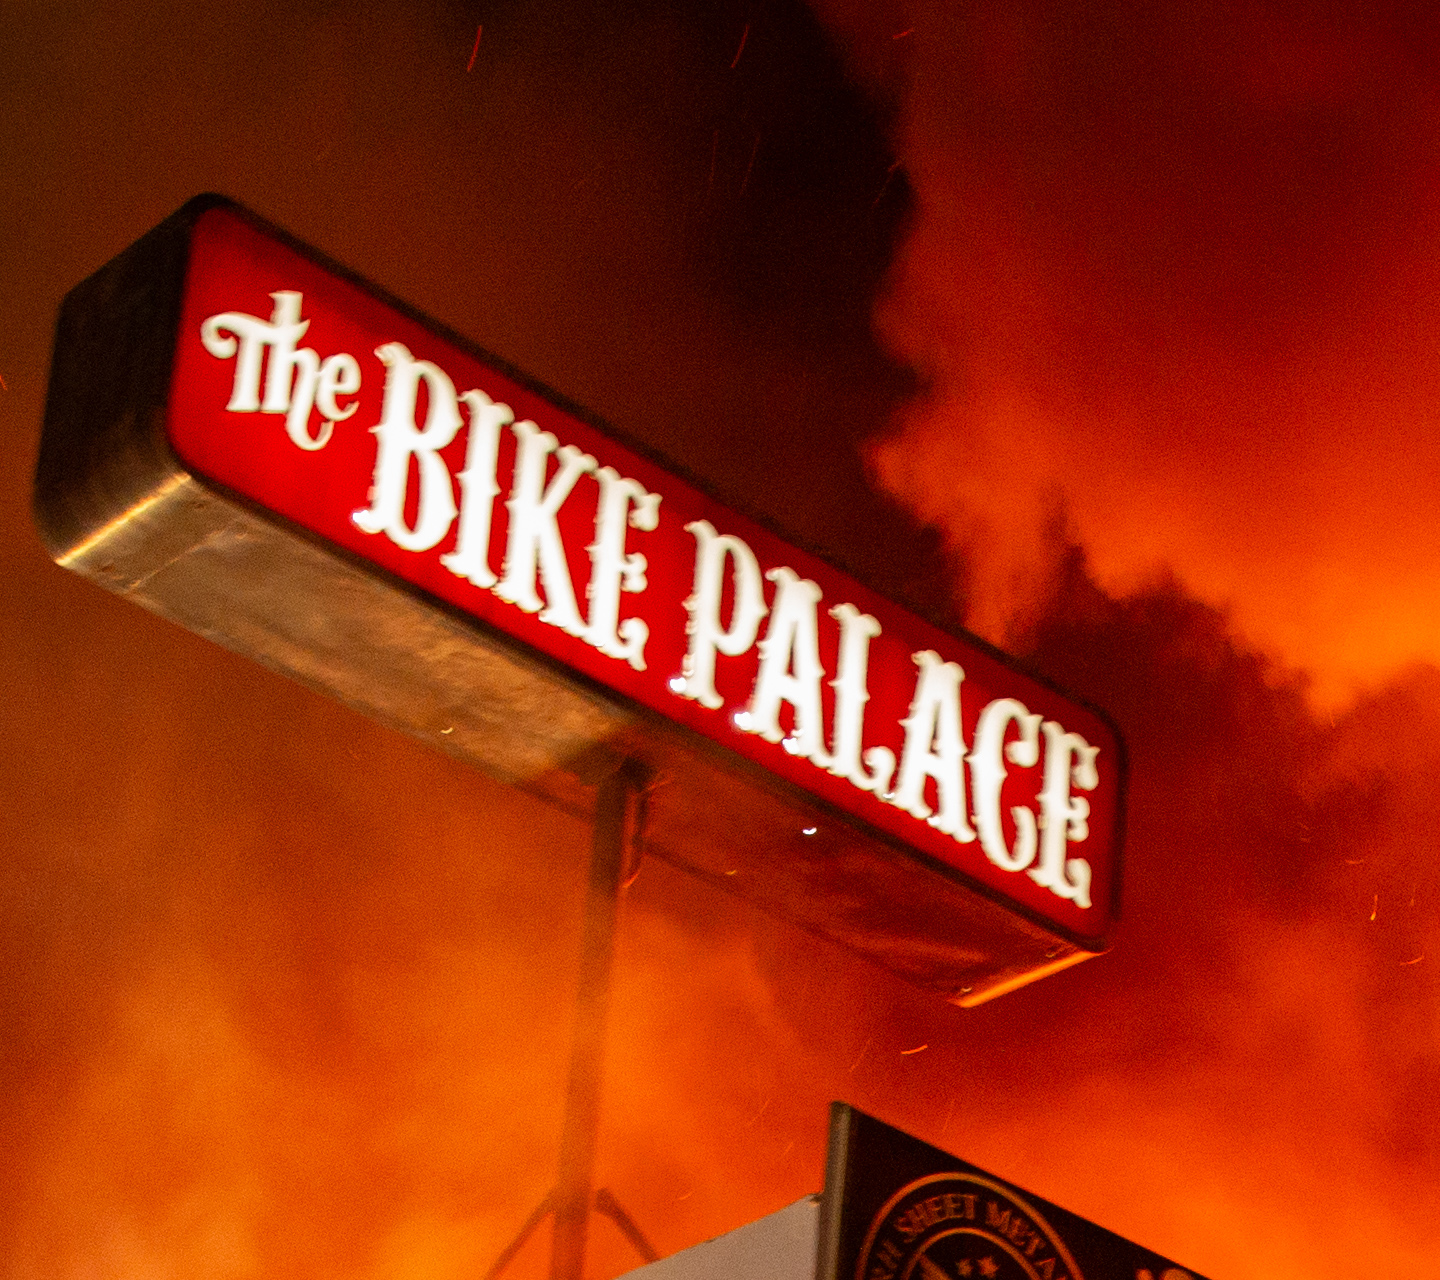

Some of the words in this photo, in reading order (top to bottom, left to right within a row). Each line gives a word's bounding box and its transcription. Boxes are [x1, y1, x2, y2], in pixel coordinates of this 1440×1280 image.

[351, 342, 663, 672] BIKE
[668, 520, 1101, 908] PALACE
[893, 1192, 978, 1242] SHEET
